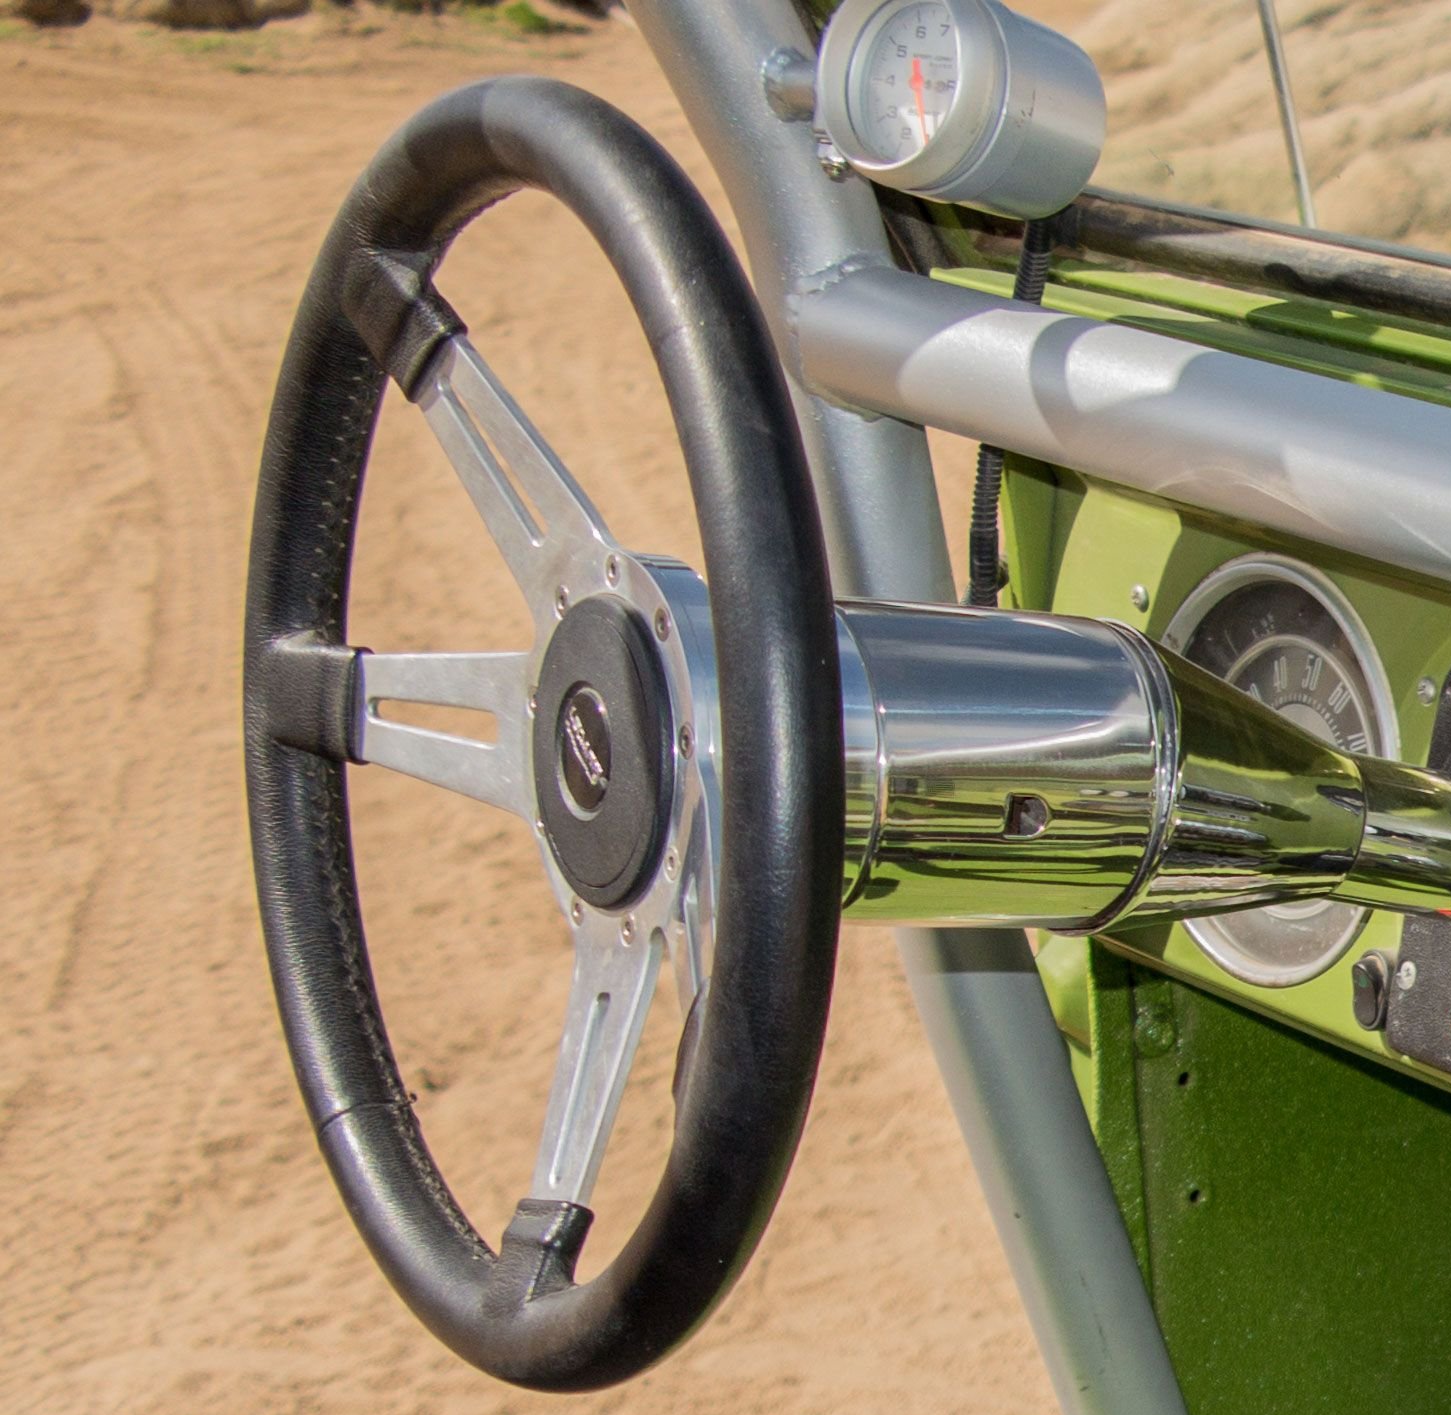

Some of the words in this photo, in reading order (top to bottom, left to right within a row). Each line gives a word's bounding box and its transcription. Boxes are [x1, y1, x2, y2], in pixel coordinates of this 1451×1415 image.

[915, 26, 927, 39] 6
[896, 45, 908, 58] 5
[1273, 656, 1288, 693] 40
[1302, 653, 1322, 691] 50
[1328, 681, 1351, 714] 60
